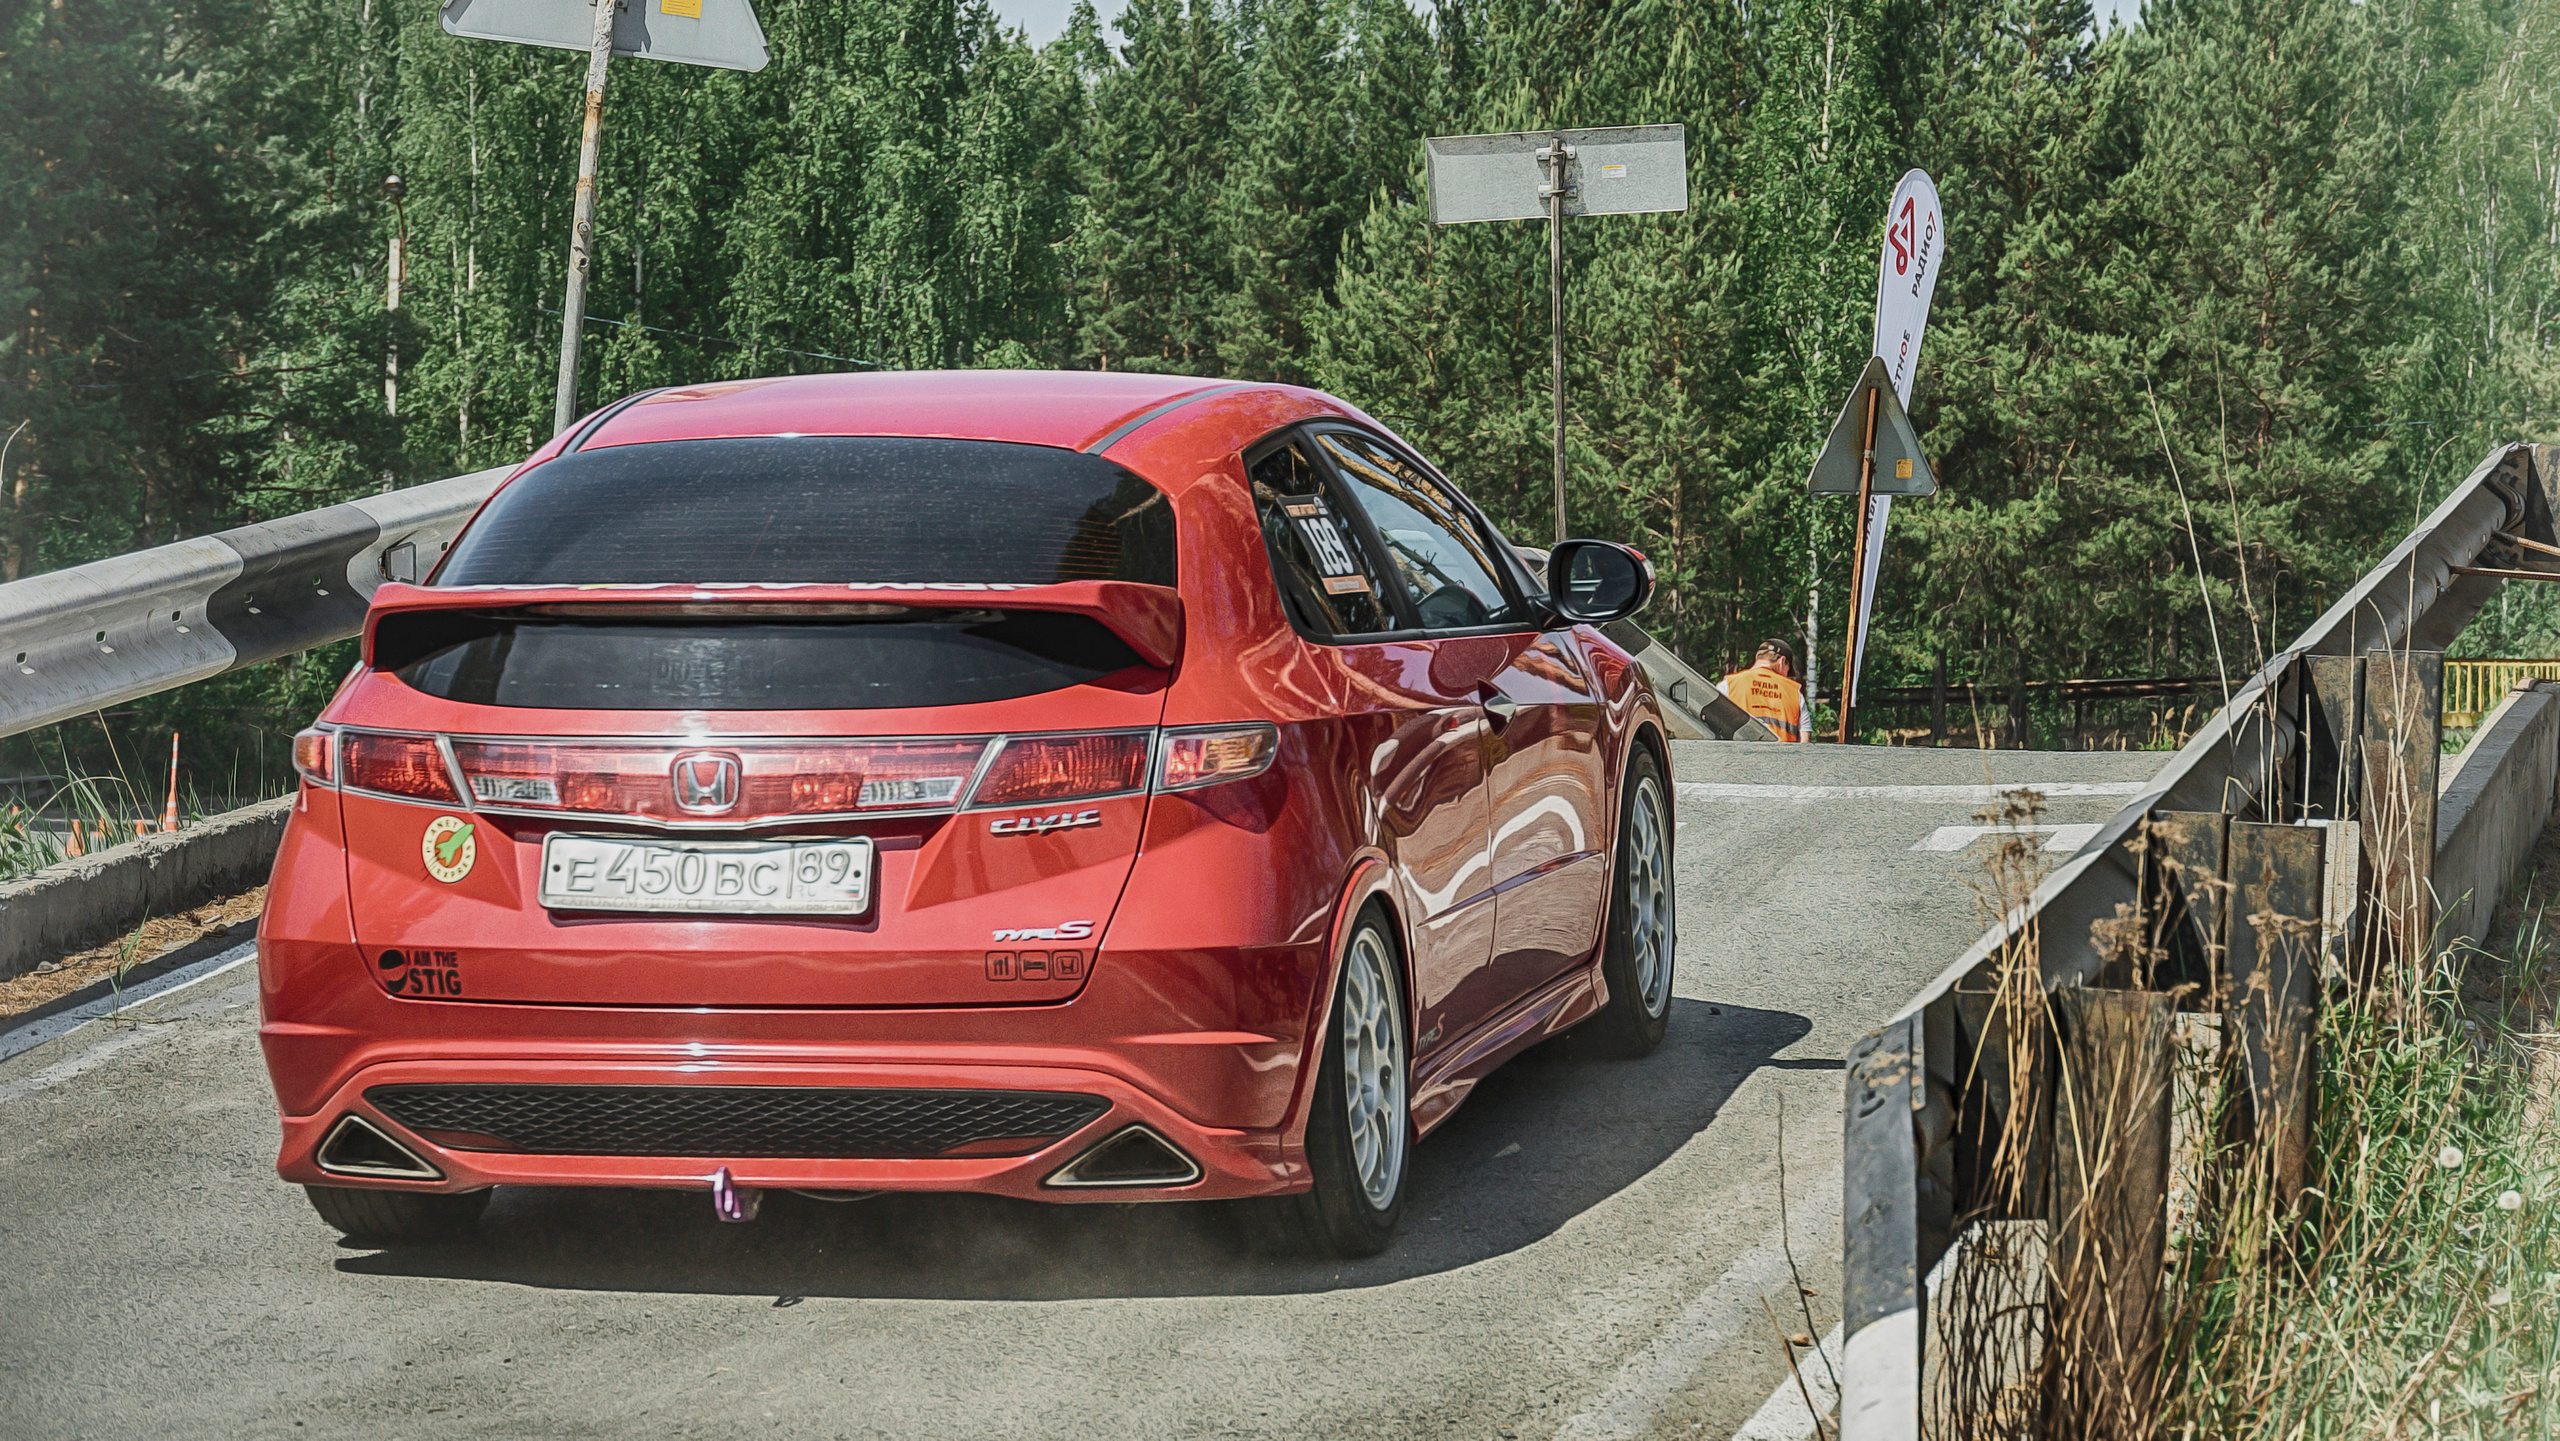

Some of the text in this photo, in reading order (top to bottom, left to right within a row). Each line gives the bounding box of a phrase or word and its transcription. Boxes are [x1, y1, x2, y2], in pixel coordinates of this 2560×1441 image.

[1892, 329, 1911, 394] СТНОЕ
[1298, 517, 1354, 575] 189
[1752, 680, 1779, 690] СУДЬЯ
[990, 809, 1101, 834] CIVIC
[797, 848, 851, 884] 89
[406, 949, 458, 968] I AM THE
[409, 967, 462, 995] STIG
